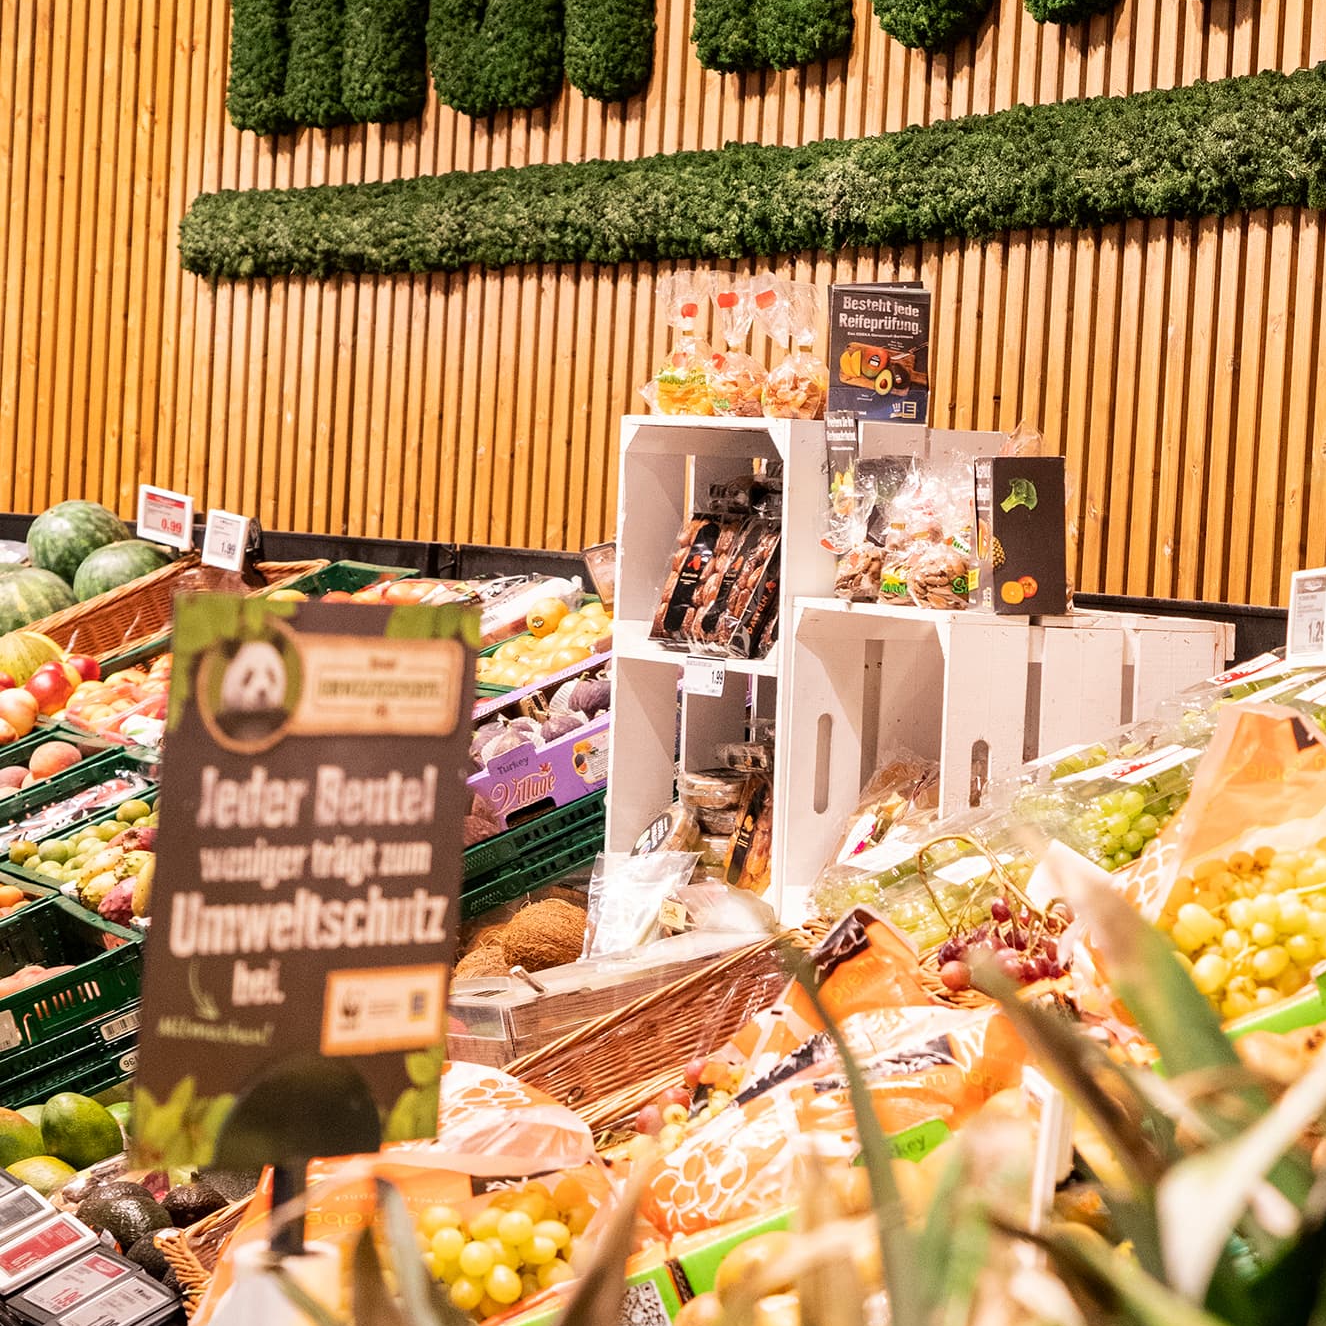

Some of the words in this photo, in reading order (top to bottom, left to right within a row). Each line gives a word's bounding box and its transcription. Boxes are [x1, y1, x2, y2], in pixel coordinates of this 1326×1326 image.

[843, 295, 892, 313] Besteht
[893, 300, 919, 317] jede
[839, 312, 922, 335] Reifeprüfung.
[161, 517, 182, 534] 0.99
[220, 541, 236, 556] 1.99
[497, 757, 529, 775] Turkey
[315, 763, 439, 825] Beutel
[491, 773, 556, 816] Village
[200, 839, 307, 889] weniger
[311, 836, 375, 888] trägt
[379, 840, 433, 877] zum
[170, 885, 449, 958] Umweltschutz
[231, 959, 286, 1006] bei.
